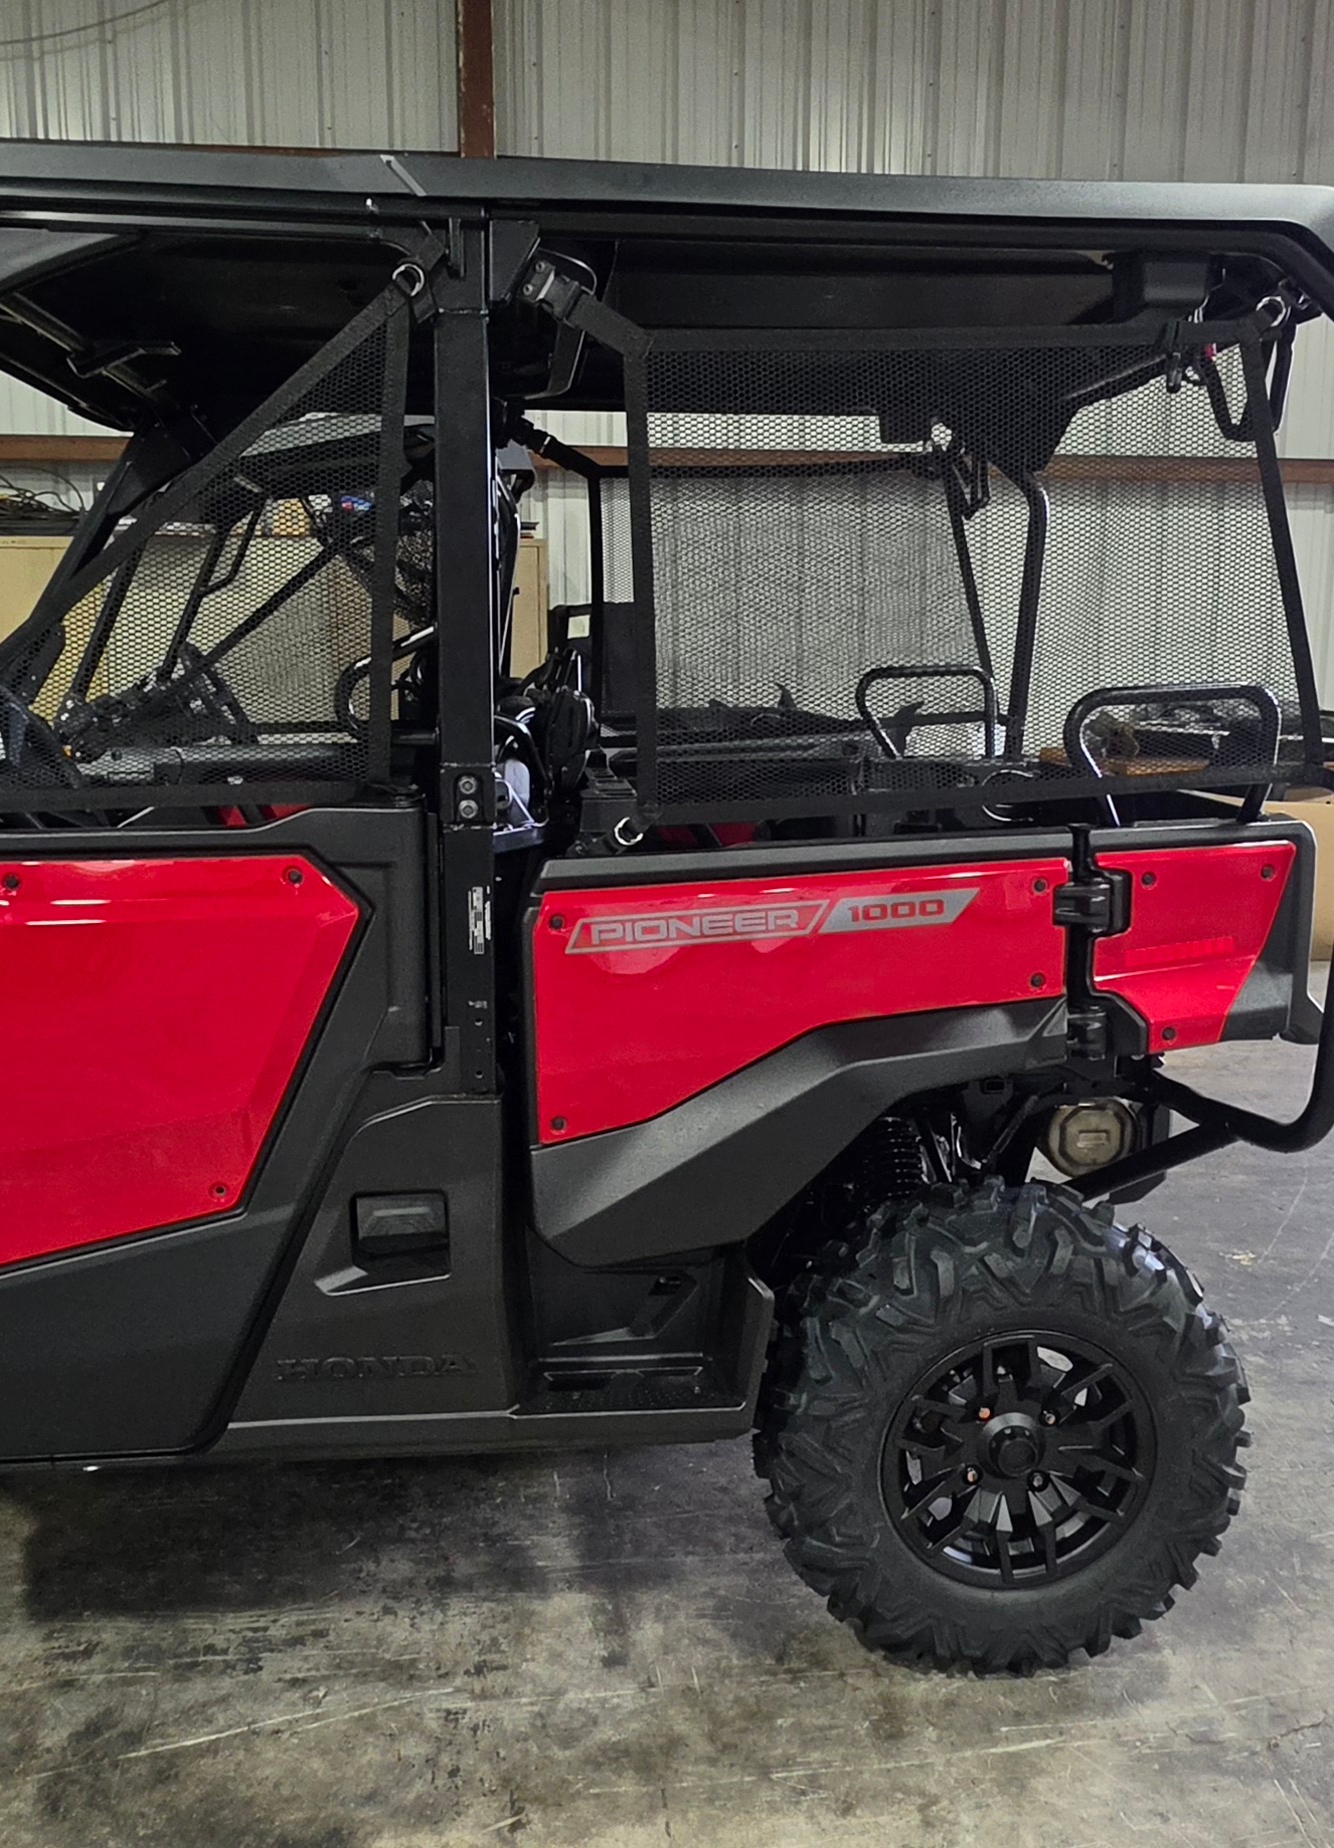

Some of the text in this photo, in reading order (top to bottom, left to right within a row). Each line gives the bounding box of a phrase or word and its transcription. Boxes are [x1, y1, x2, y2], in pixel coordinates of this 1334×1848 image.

[590, 899, 946, 945] PIONEER 1000
[272, 1354, 479, 1381] HONDA
